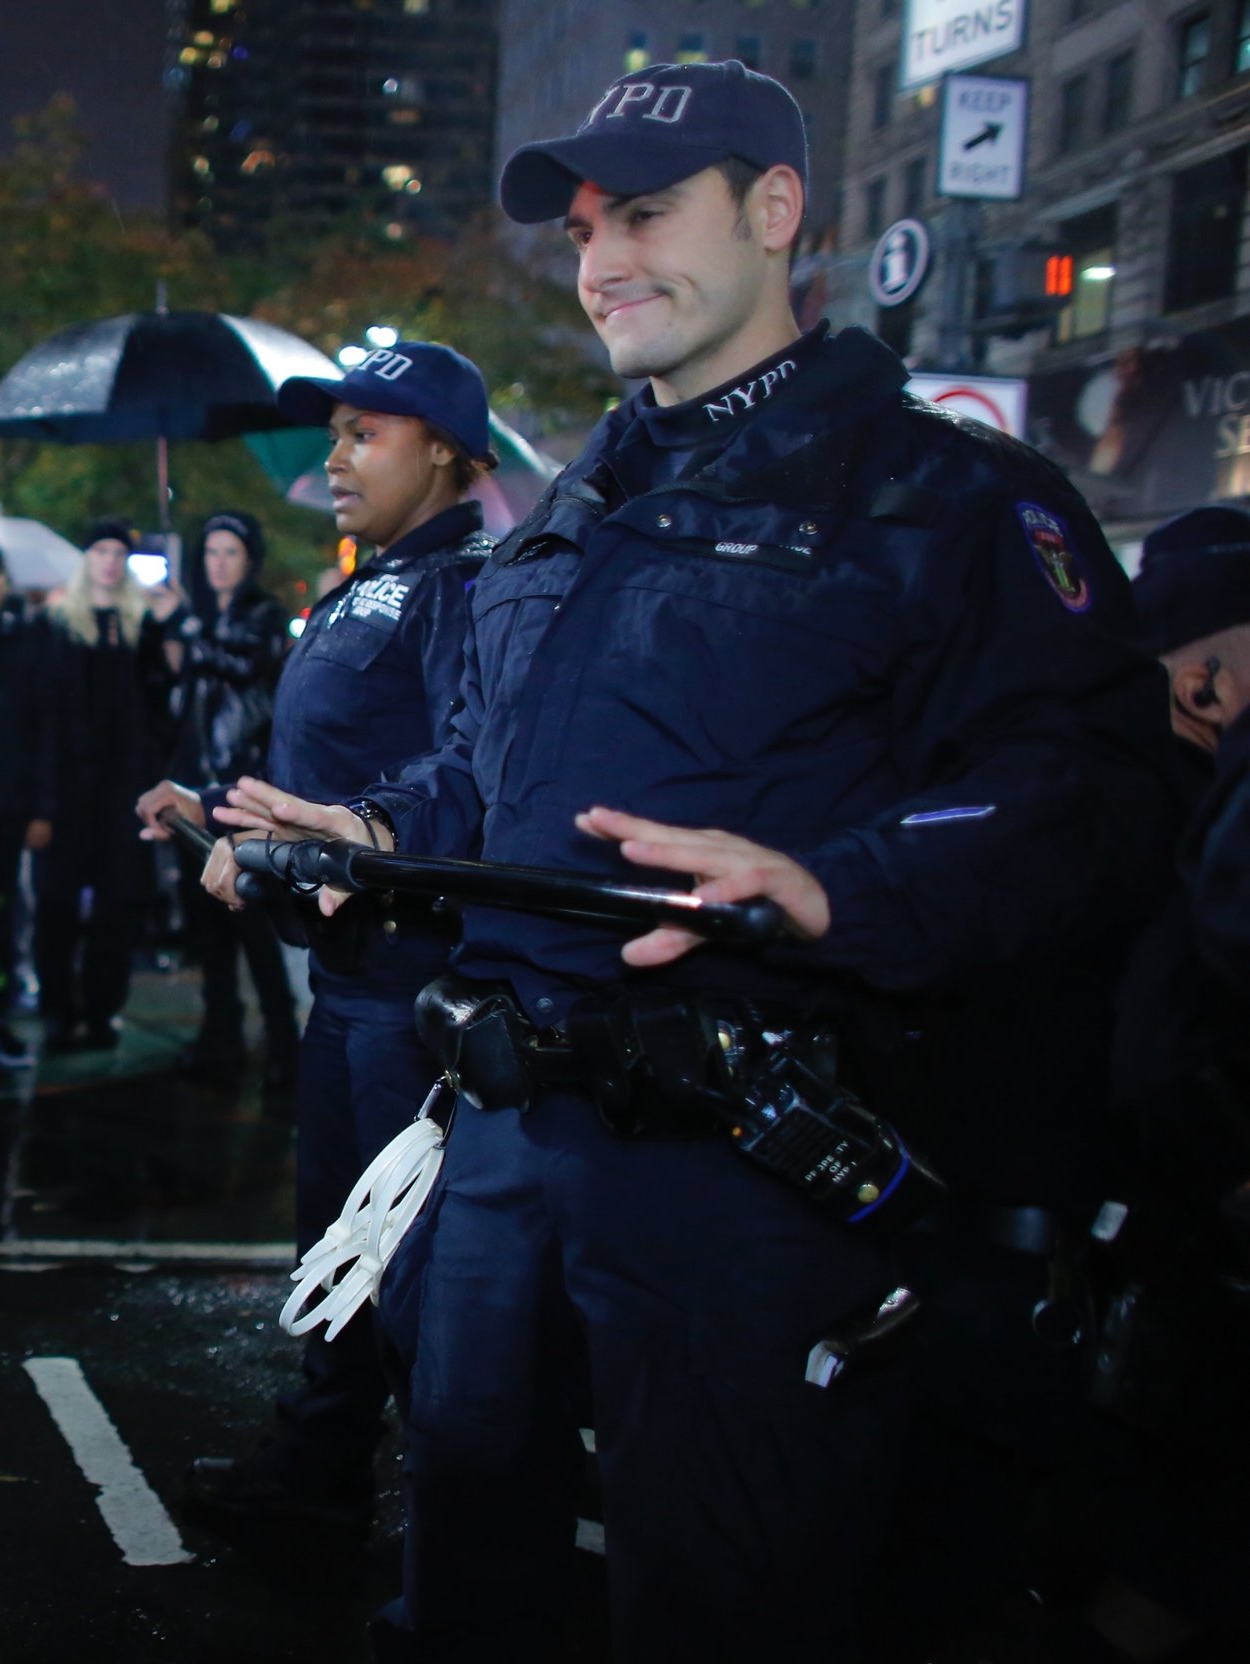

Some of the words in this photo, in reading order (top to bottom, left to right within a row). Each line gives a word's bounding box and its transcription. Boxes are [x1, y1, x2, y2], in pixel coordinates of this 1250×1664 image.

[911, 3, 1013, 62] TURNS
[584, 83, 692, 129] YPD
[957, 89, 1012, 112] KEEP
[950, 160, 1011, 184] RIGHT
[714, 541, 759, 555] GROUP
[828, 1160, 842, 1173] OF
[831, 1160, 857, 1183] NYP
